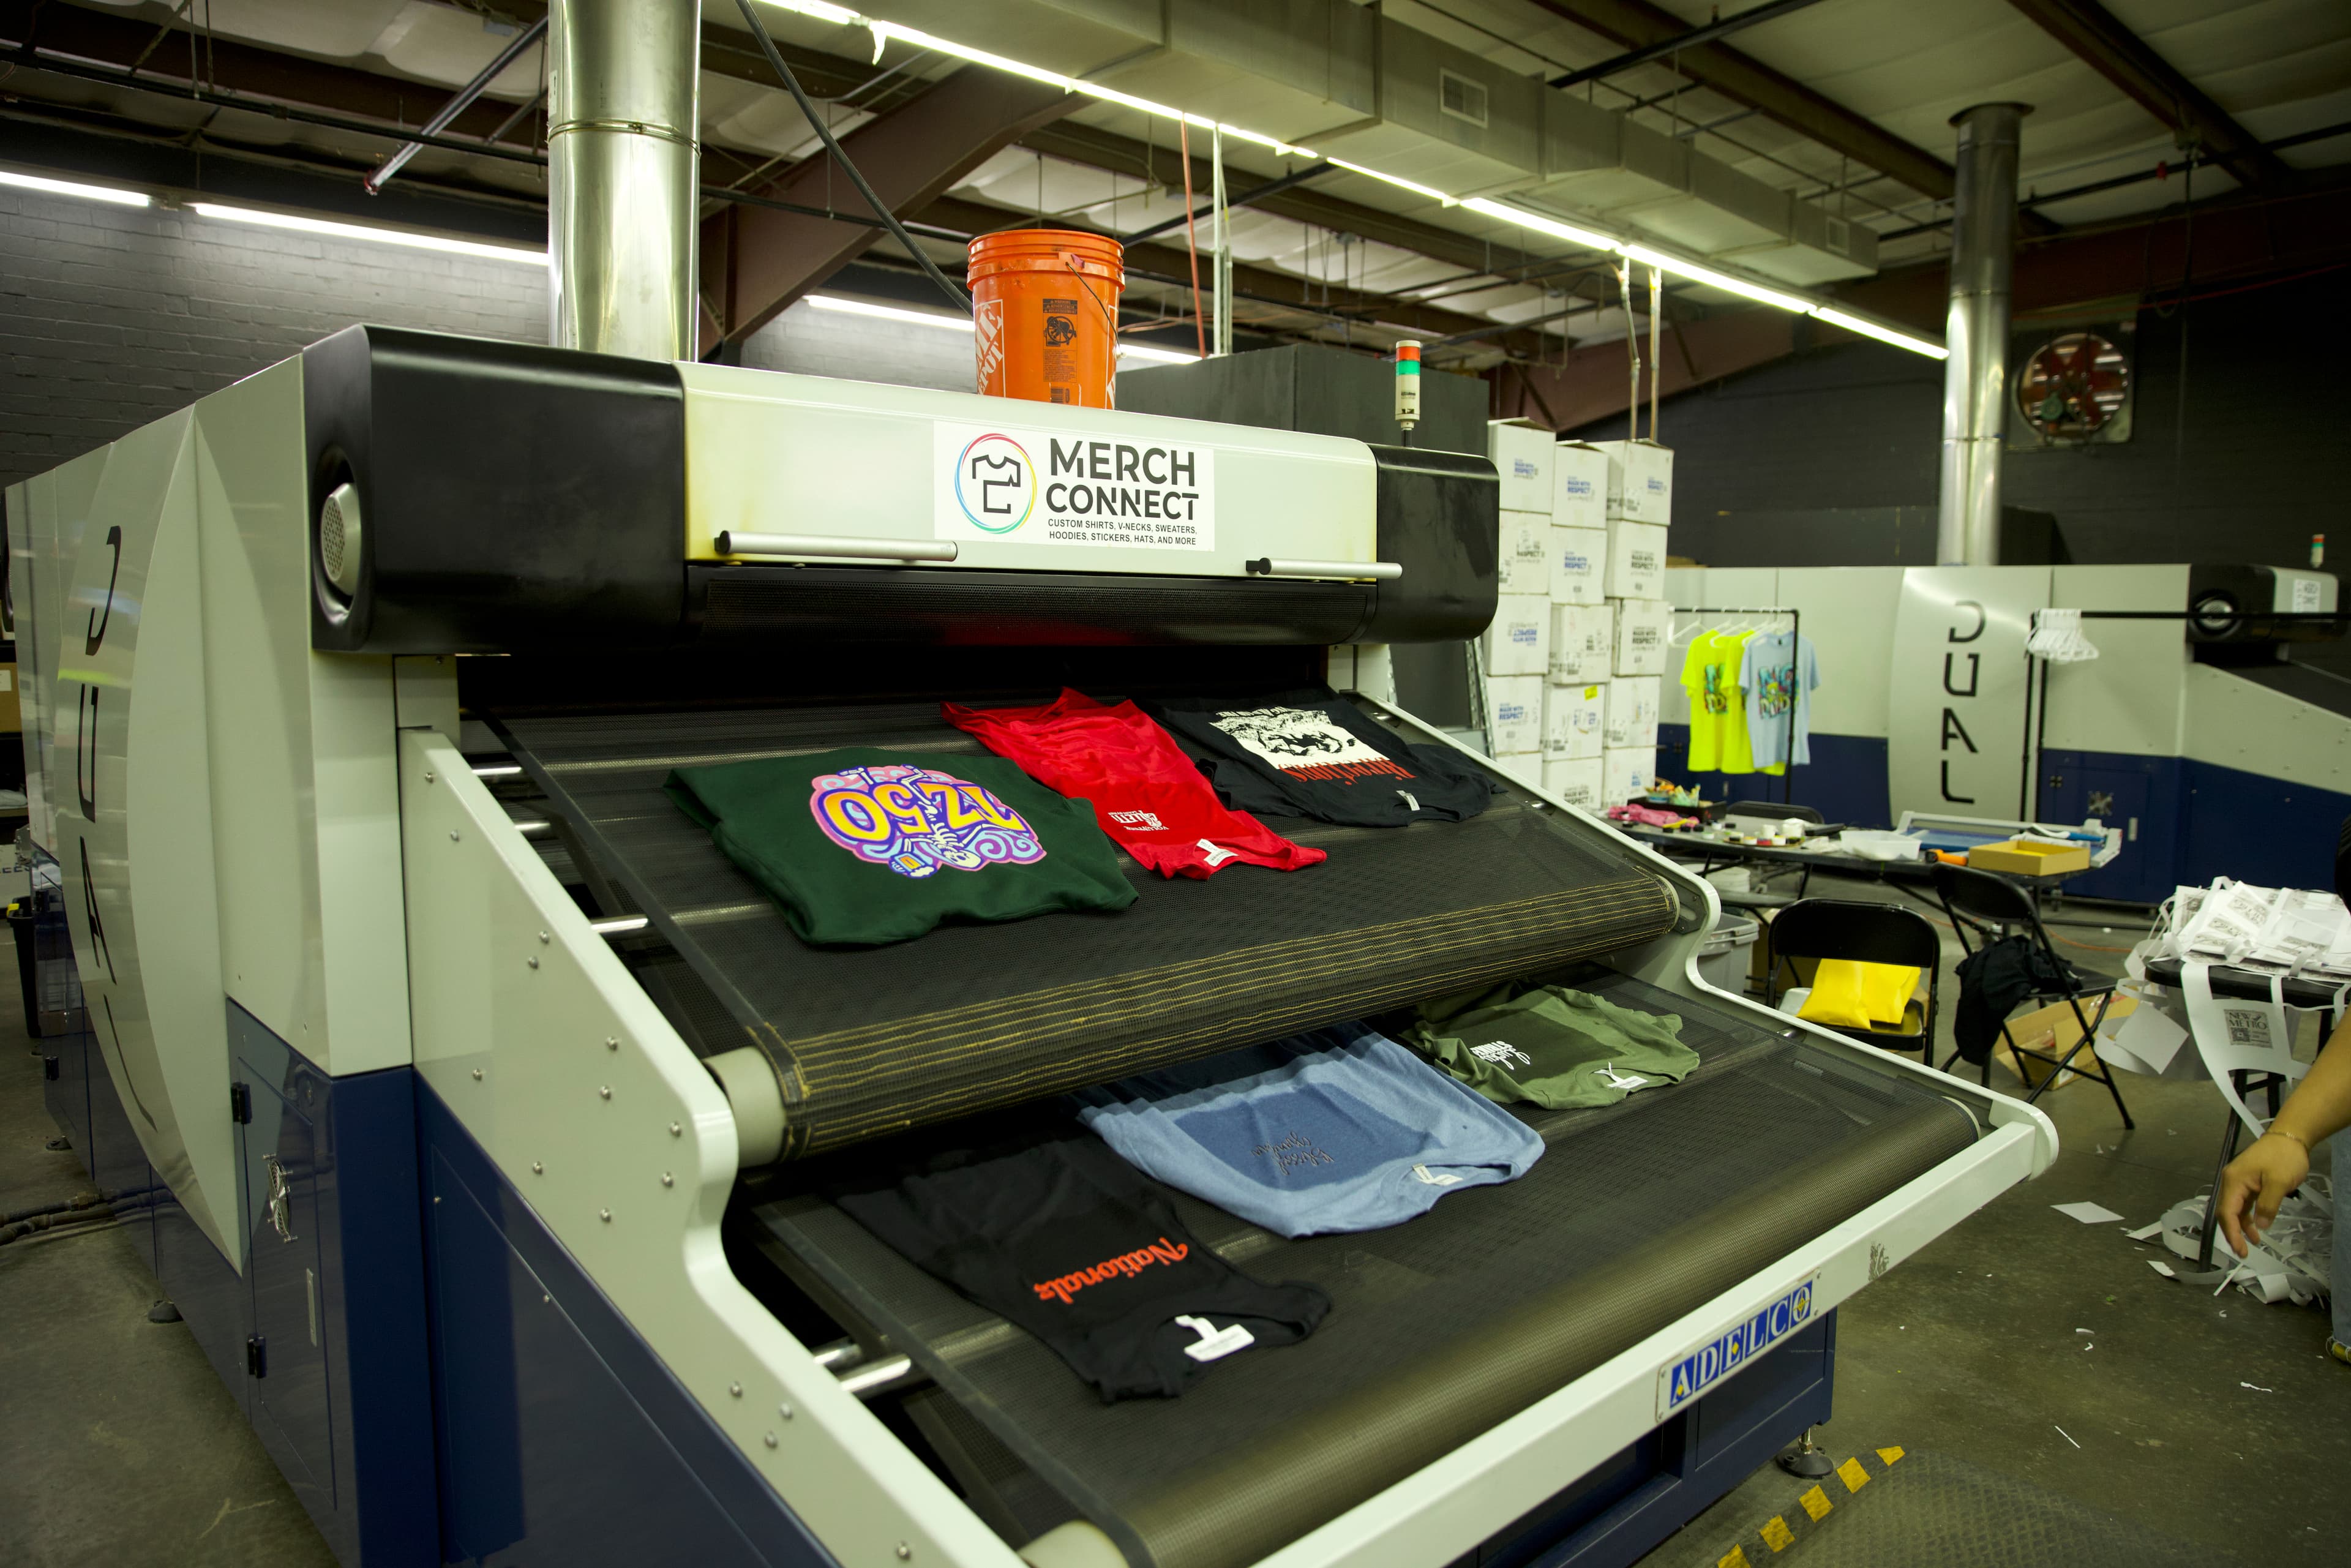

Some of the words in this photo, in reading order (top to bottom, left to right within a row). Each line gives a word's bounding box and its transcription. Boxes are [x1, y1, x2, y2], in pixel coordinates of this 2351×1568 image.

[1049, 438, 1196, 487] MERCH
[1046, 482, 1199, 520] CONNECT
[1048, 519, 1083, 528] CUSTOM
[1085, 520, 1117, 531] SHIRTS,
[1118, 522, 1153, 533] V-NECKS,
[1155, 523, 1198, 535] SWEATERS,
[1049, 531, 1089, 541] HOODIES,
[1091, 533, 1133, 543] STICKERS,
[1134, 535, 1156, 544] HATS,
[1157, 536, 1174, 544] AND
[1175, 536, 1196, 546] MORE
[1033, 1237, 1188, 1304] Nationals
[1671, 1285, 1811, 1406] ADELCO
